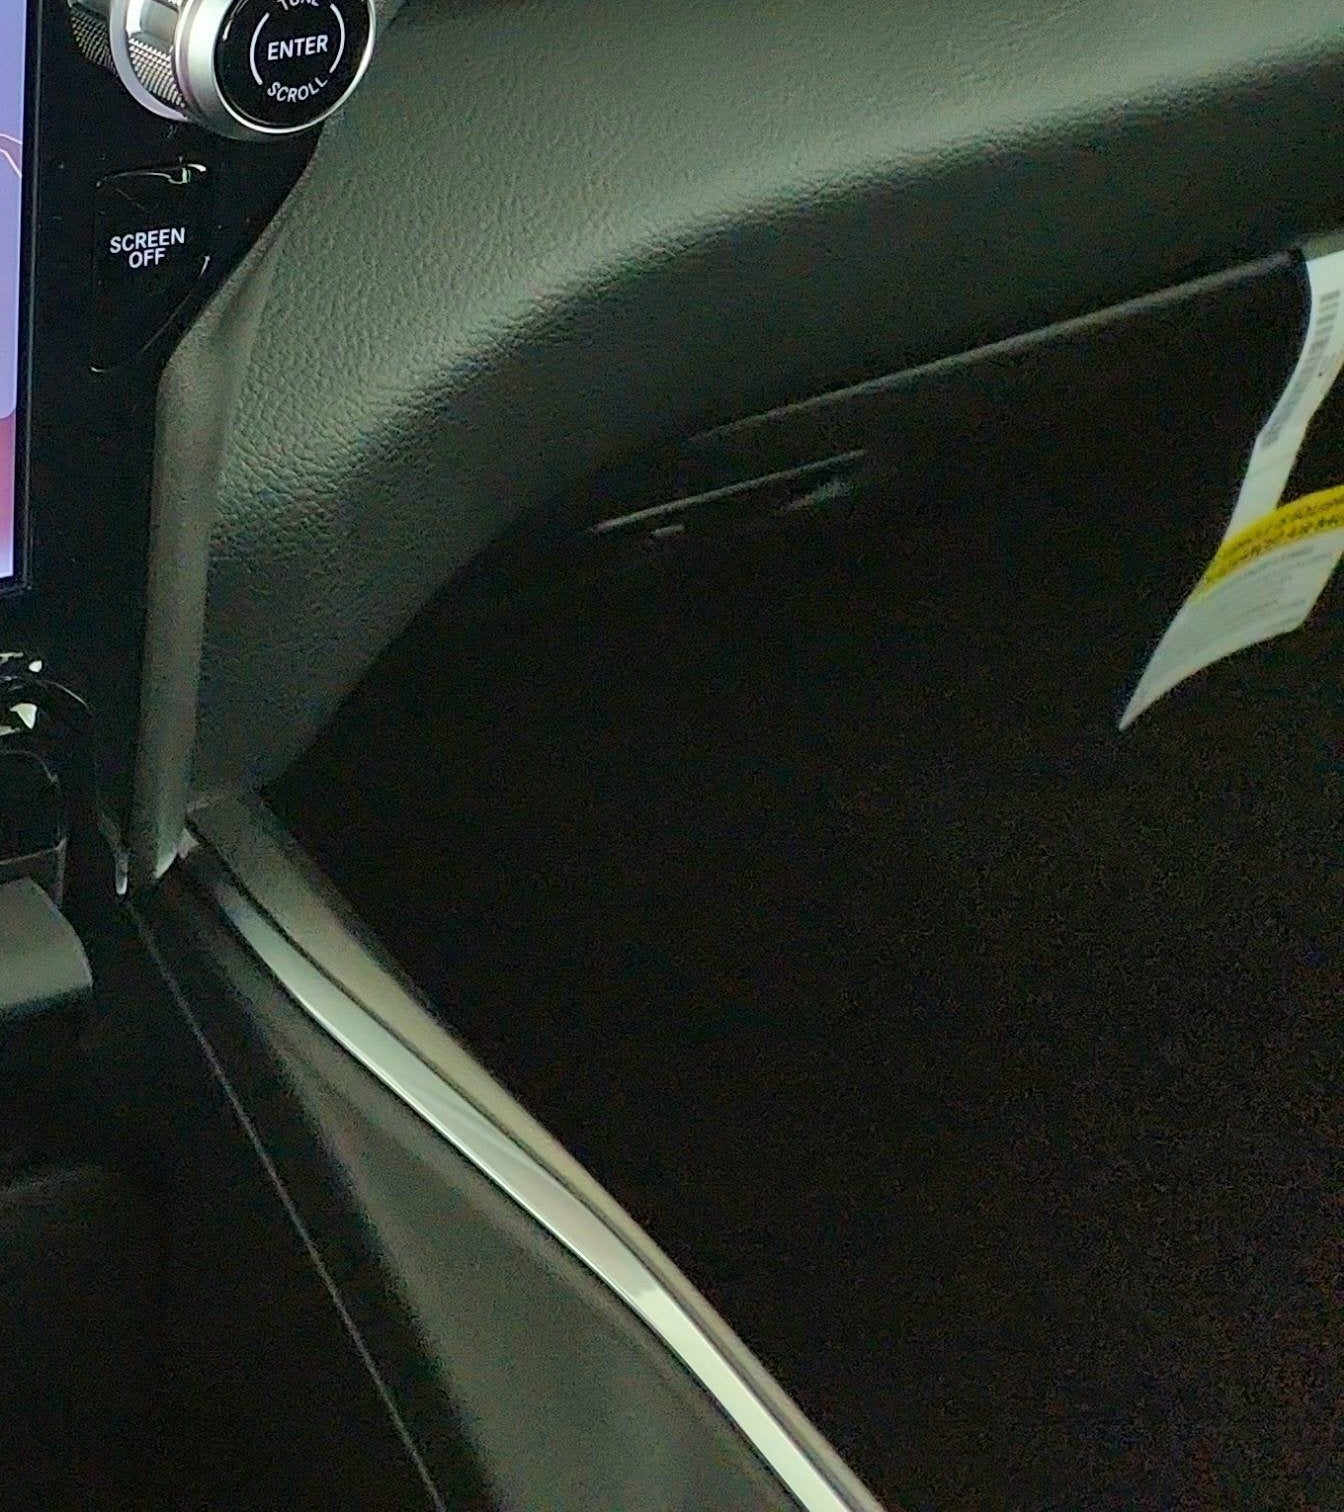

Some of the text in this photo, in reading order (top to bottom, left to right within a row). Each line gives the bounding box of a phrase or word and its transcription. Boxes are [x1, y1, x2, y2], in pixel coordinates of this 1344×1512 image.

[267, 34, 329, 61] ENTER
[267, 78, 328, 103] SCROLL
[109, 227, 185, 254] SCREEN
[128, 248, 166, 269] OFF
